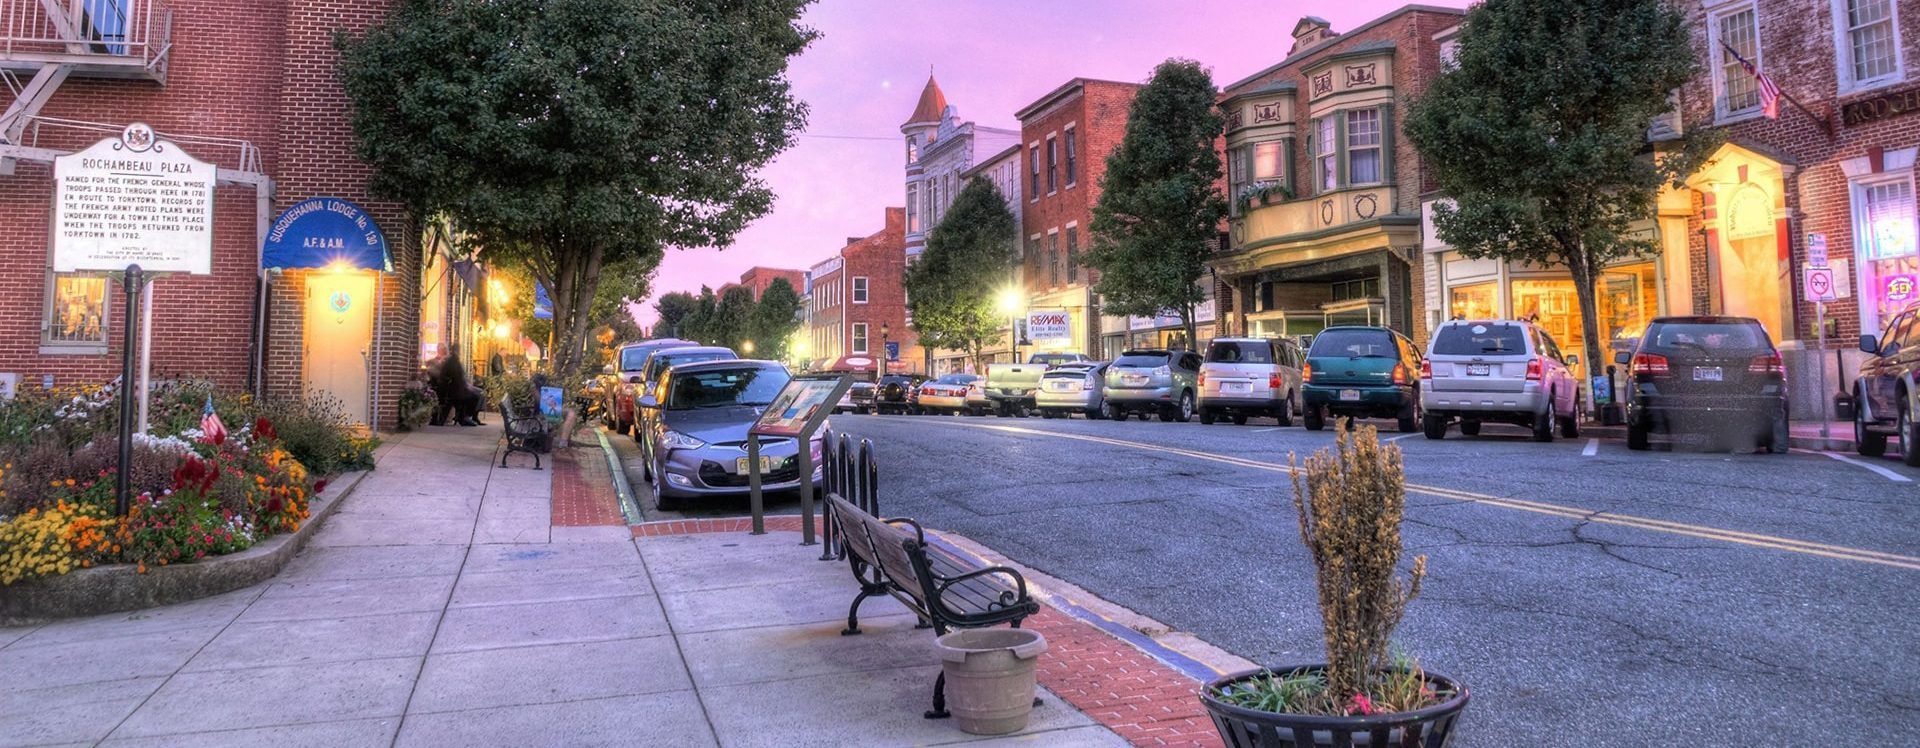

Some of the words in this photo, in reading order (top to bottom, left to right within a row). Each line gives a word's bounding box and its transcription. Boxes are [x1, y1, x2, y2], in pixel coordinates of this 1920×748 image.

[82, 158, 152, 171] ROCHAMBEAU
[161, 162, 192, 173] PLAZA
[270, 200, 324, 243] SUSQUEHANNA
[328, 200, 358, 218] LODGE
[355, 215, 367, 230] No.
[365, 231, 377, 245] 130
[304, 238, 318, 247] A.F.
[320, 238, 325, 248] &
[328, 238, 344, 248] A.M.
[1031, 314, 1065, 325] RE/MAX
